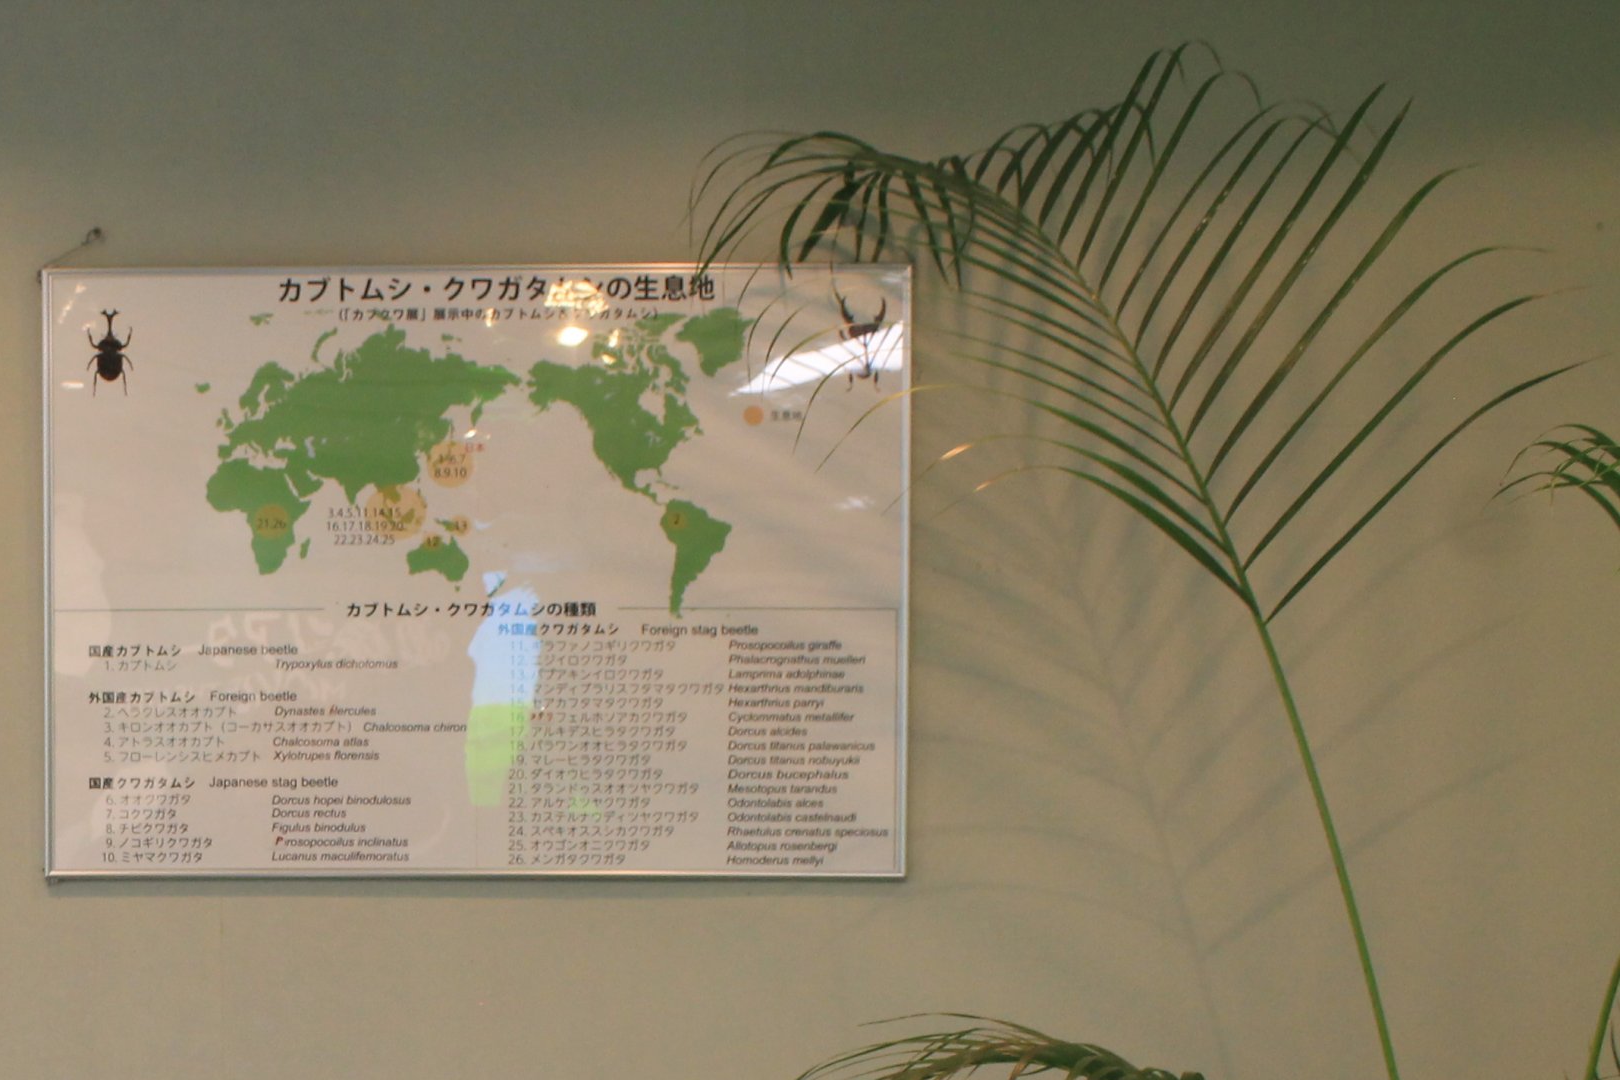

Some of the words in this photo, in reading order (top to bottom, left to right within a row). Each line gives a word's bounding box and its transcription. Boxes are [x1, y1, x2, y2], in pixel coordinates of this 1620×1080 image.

[279, 275, 715, 303] カブトムシ・クワガタの生息地
[347, 602, 597, 617] カブトムシ・クワガタムシの種類
[641, 624, 687, 636] Foreign
[691, 624, 717, 636] stag
[721, 624, 758, 635] beetle
[89, 645, 182, 658] 国産カブトムシ
[198, 644, 257, 657] Japanese
[261, 644, 298, 655] beetle
[275, 659, 333, 671] Trypoxylus
[335, 659, 398, 670] dichotomus
[210, 690, 256, 703] Foreign
[260, 690, 298, 702] beetle
[275, 706, 326, 718] Dynastes
[363, 722, 431, 733] Chalcosoma
[434, 722, 467, 733] chiron
[728, 726, 767, 737] Dorcus
[273, 736, 340, 747] Chalcosoma
[343, 737, 370, 747] atlas
[728, 740, 767, 751] Dorcus
[273, 750, 331, 762] Xylotrupes
[333, 750, 380, 761] florensis
[728, 755, 767, 765] Dorcus
[728, 769, 773, 780] Dorcus
[776, 769, 849, 782] bucephalus
[89, 777, 196, 790] 国産クワガタムシ
[209, 776, 268, 789] Japanese
[272, 777, 298, 789] stag
[300, 776, 339, 788] beetle
[727, 783, 787, 795] Mesotopus
[789, 783, 837, 794] tarandus
[271, 795, 311, 806] Dorcus
[313, 794, 342, 808] hopei
[344, 794, 412, 806] binodulosus
[727, 797, 792, 808] Odontolabis
[271, 808, 311, 819] Dorcus
[313, 808, 347, 819] rectus
[727, 812, 792, 822] Odontolabis
[271, 822, 311, 834] Figulus
[314, 822, 366, 833] binodulus
[784, 826, 832, 836] crenatus
[357, 836, 409, 848] inclinatus
[727, 840, 777, 852] Allotopus
[102, 852, 117, 863] 10.
[271, 851, 318, 863] Lucanus
[320, 851, 409, 862] maculifemoratus
[726, 855, 790, 865] Homoderus
